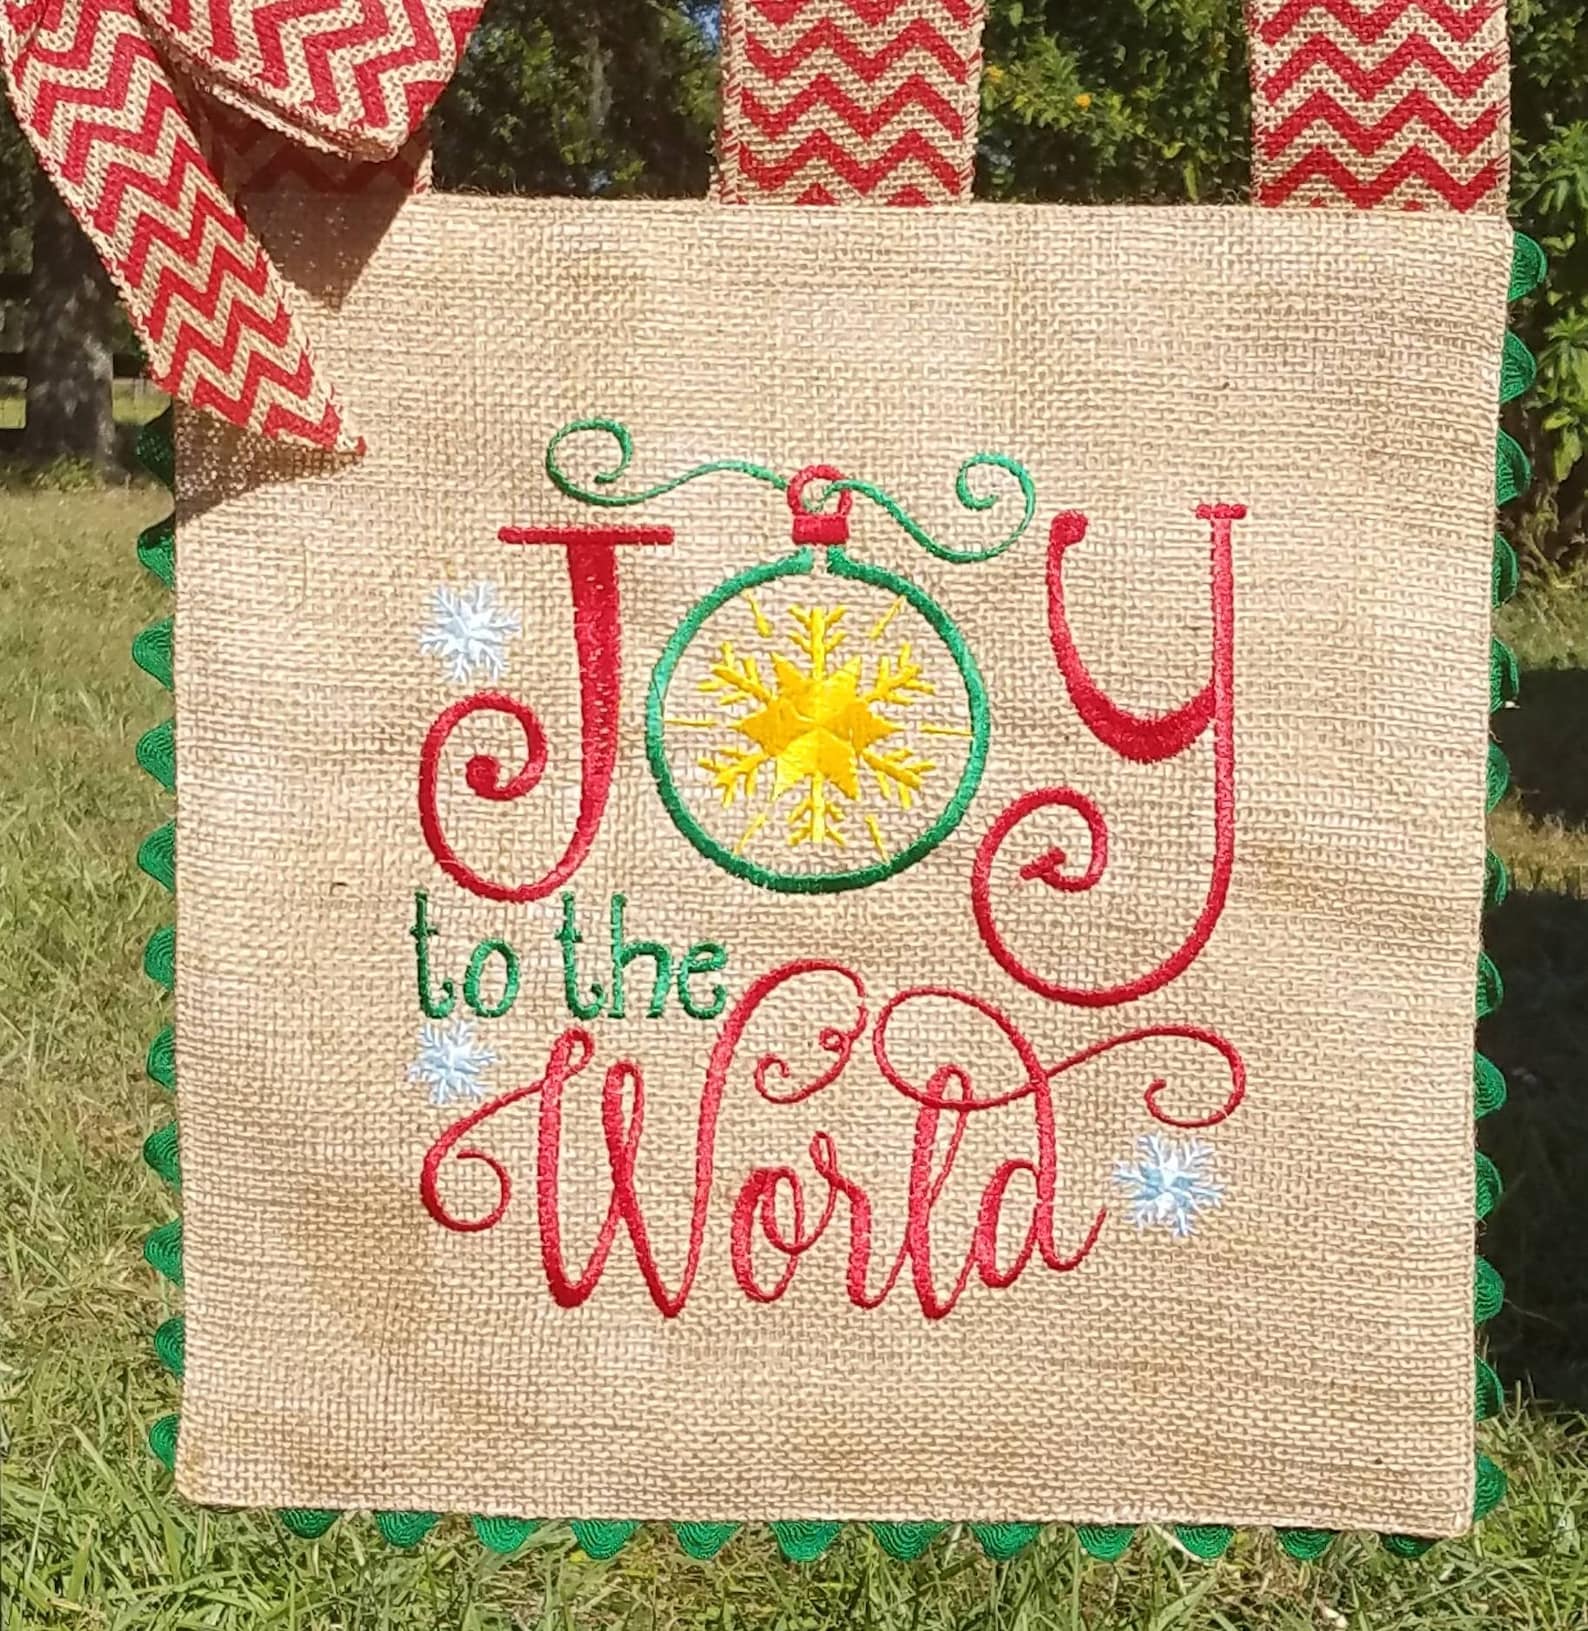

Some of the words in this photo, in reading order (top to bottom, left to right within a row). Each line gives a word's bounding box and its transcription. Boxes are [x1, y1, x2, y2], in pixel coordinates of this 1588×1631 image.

[411, 890, 520, 1020] to
[555, 891, 727, 1019] the
[420, 959, 1246, 1320] World
